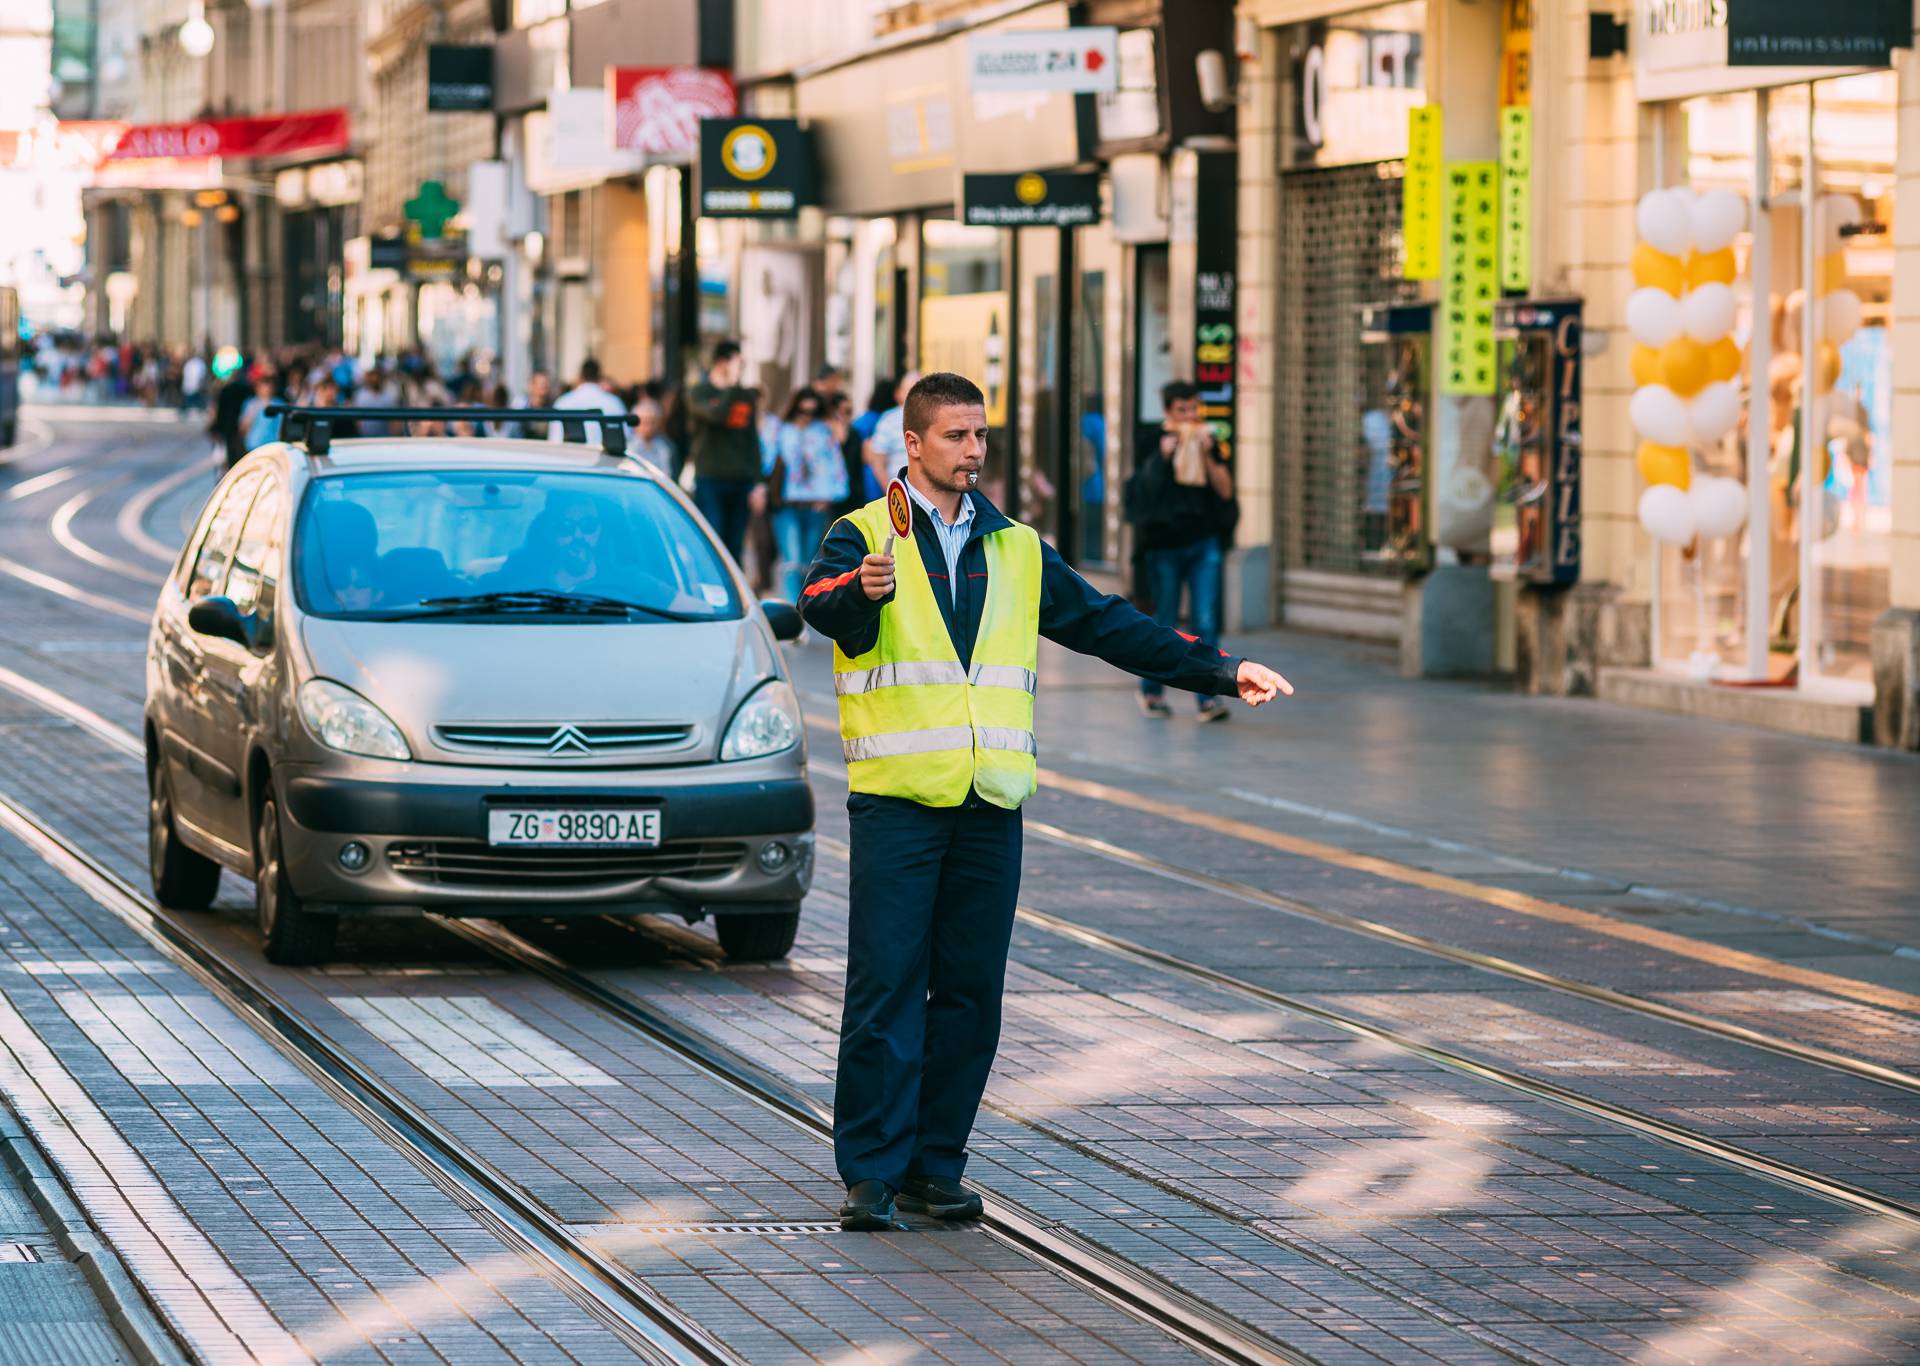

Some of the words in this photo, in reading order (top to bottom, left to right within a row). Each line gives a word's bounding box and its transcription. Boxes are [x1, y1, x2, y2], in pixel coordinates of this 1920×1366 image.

[1733, 34, 1886, 53] intimissimi
[1556, 314, 1581, 566] CIPELE
[891, 491, 907, 526] STOP
[509, 813, 540, 840] ZG
